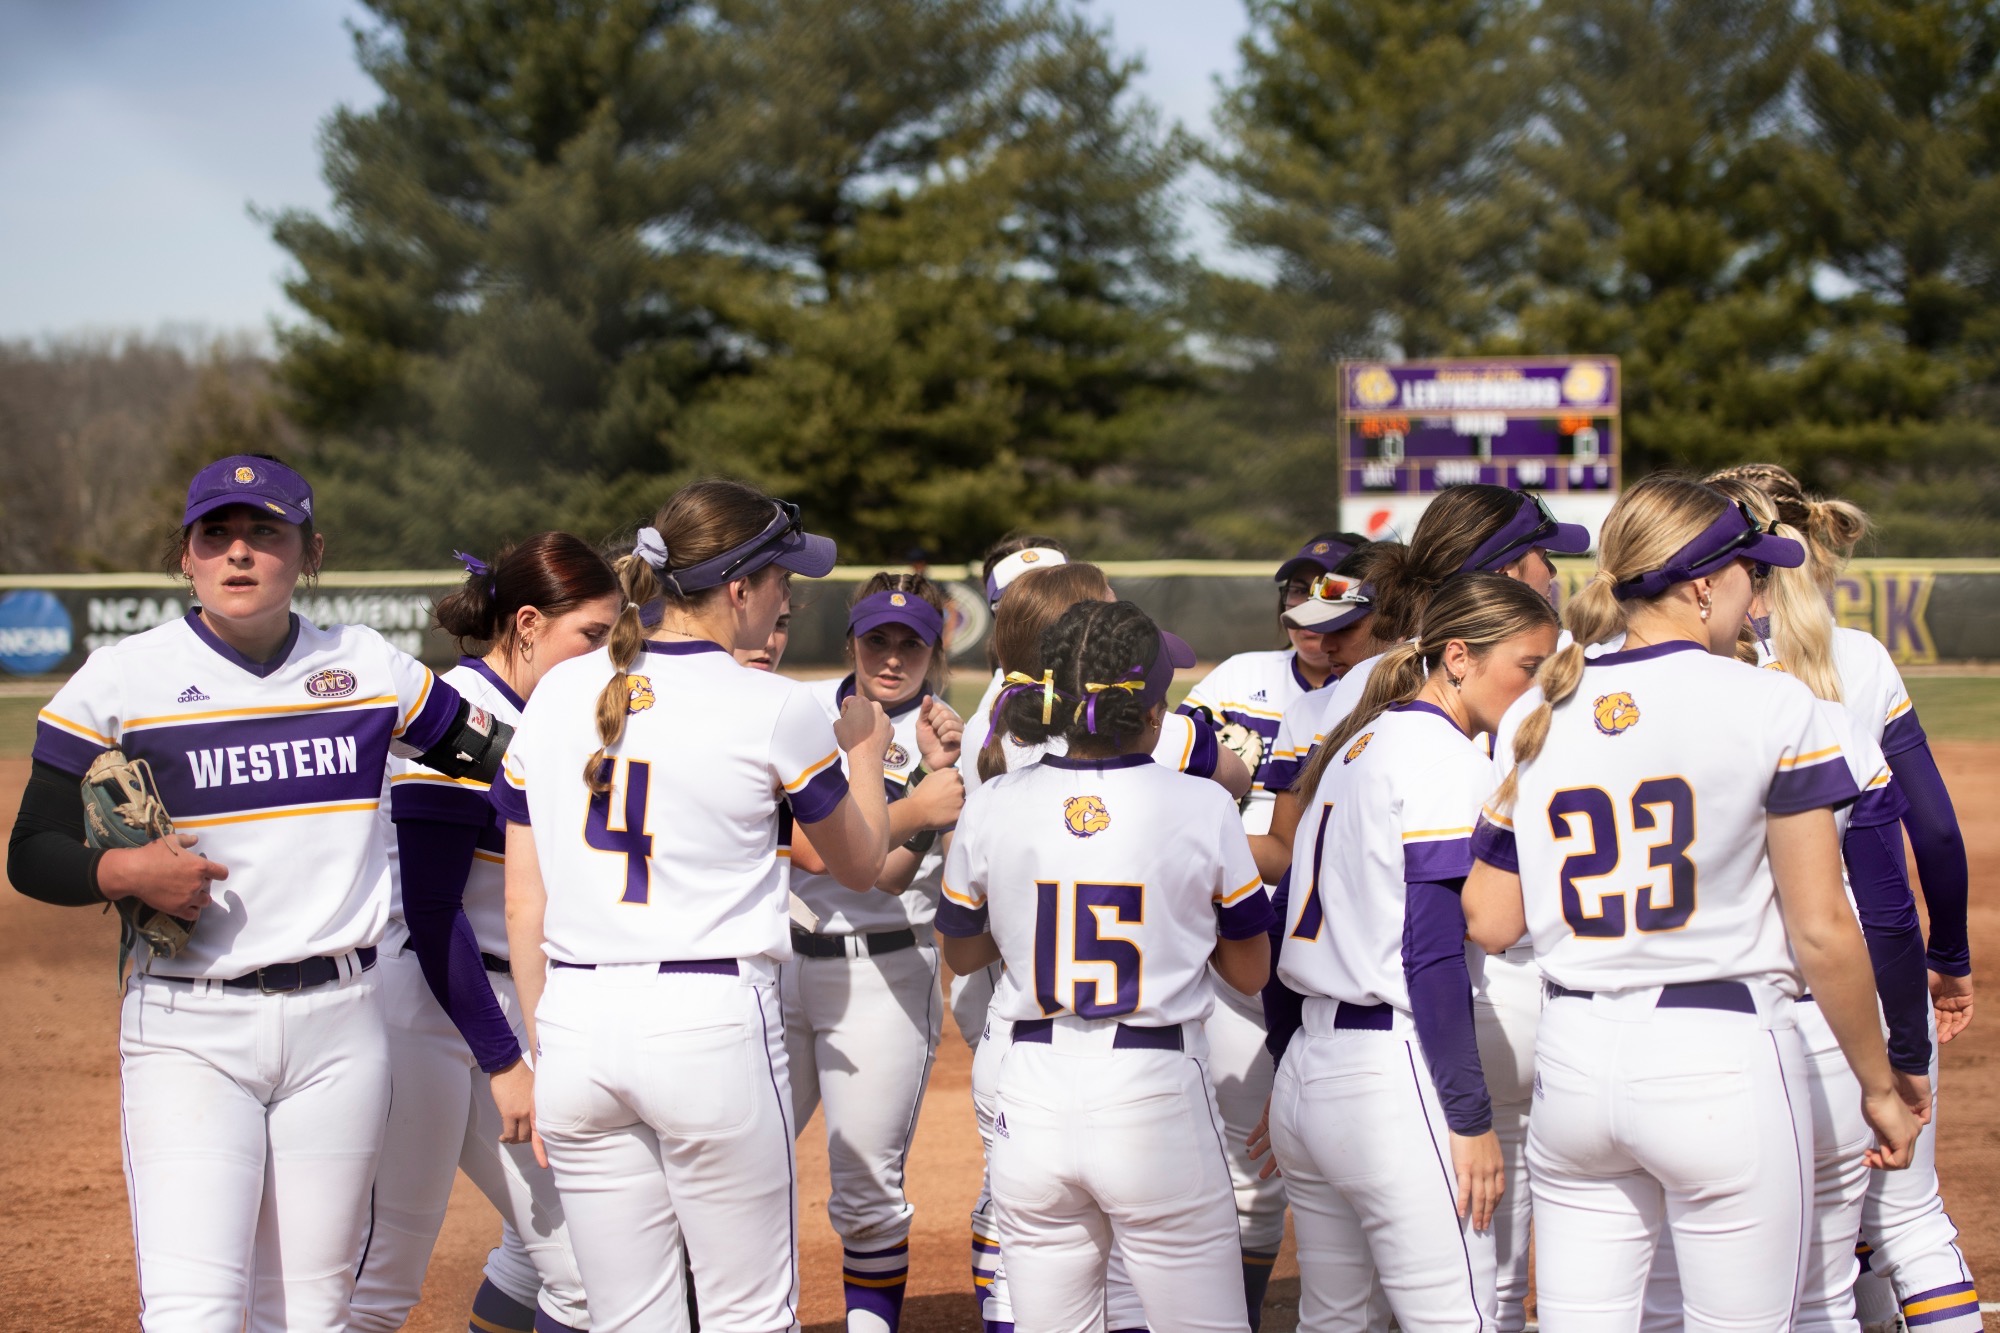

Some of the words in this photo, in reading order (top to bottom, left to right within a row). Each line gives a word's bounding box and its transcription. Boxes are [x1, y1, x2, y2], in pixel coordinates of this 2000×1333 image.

[88, 598, 184, 632] NCAA
[177, 694, 210, 704] adidas
[316, 676, 347, 692] OVC
[186, 736, 357, 789] WESTERN
[582, 754, 654, 906] 4
[1546, 774, 1698, 941] 23
[1033, 879, 1145, 1021] 15
